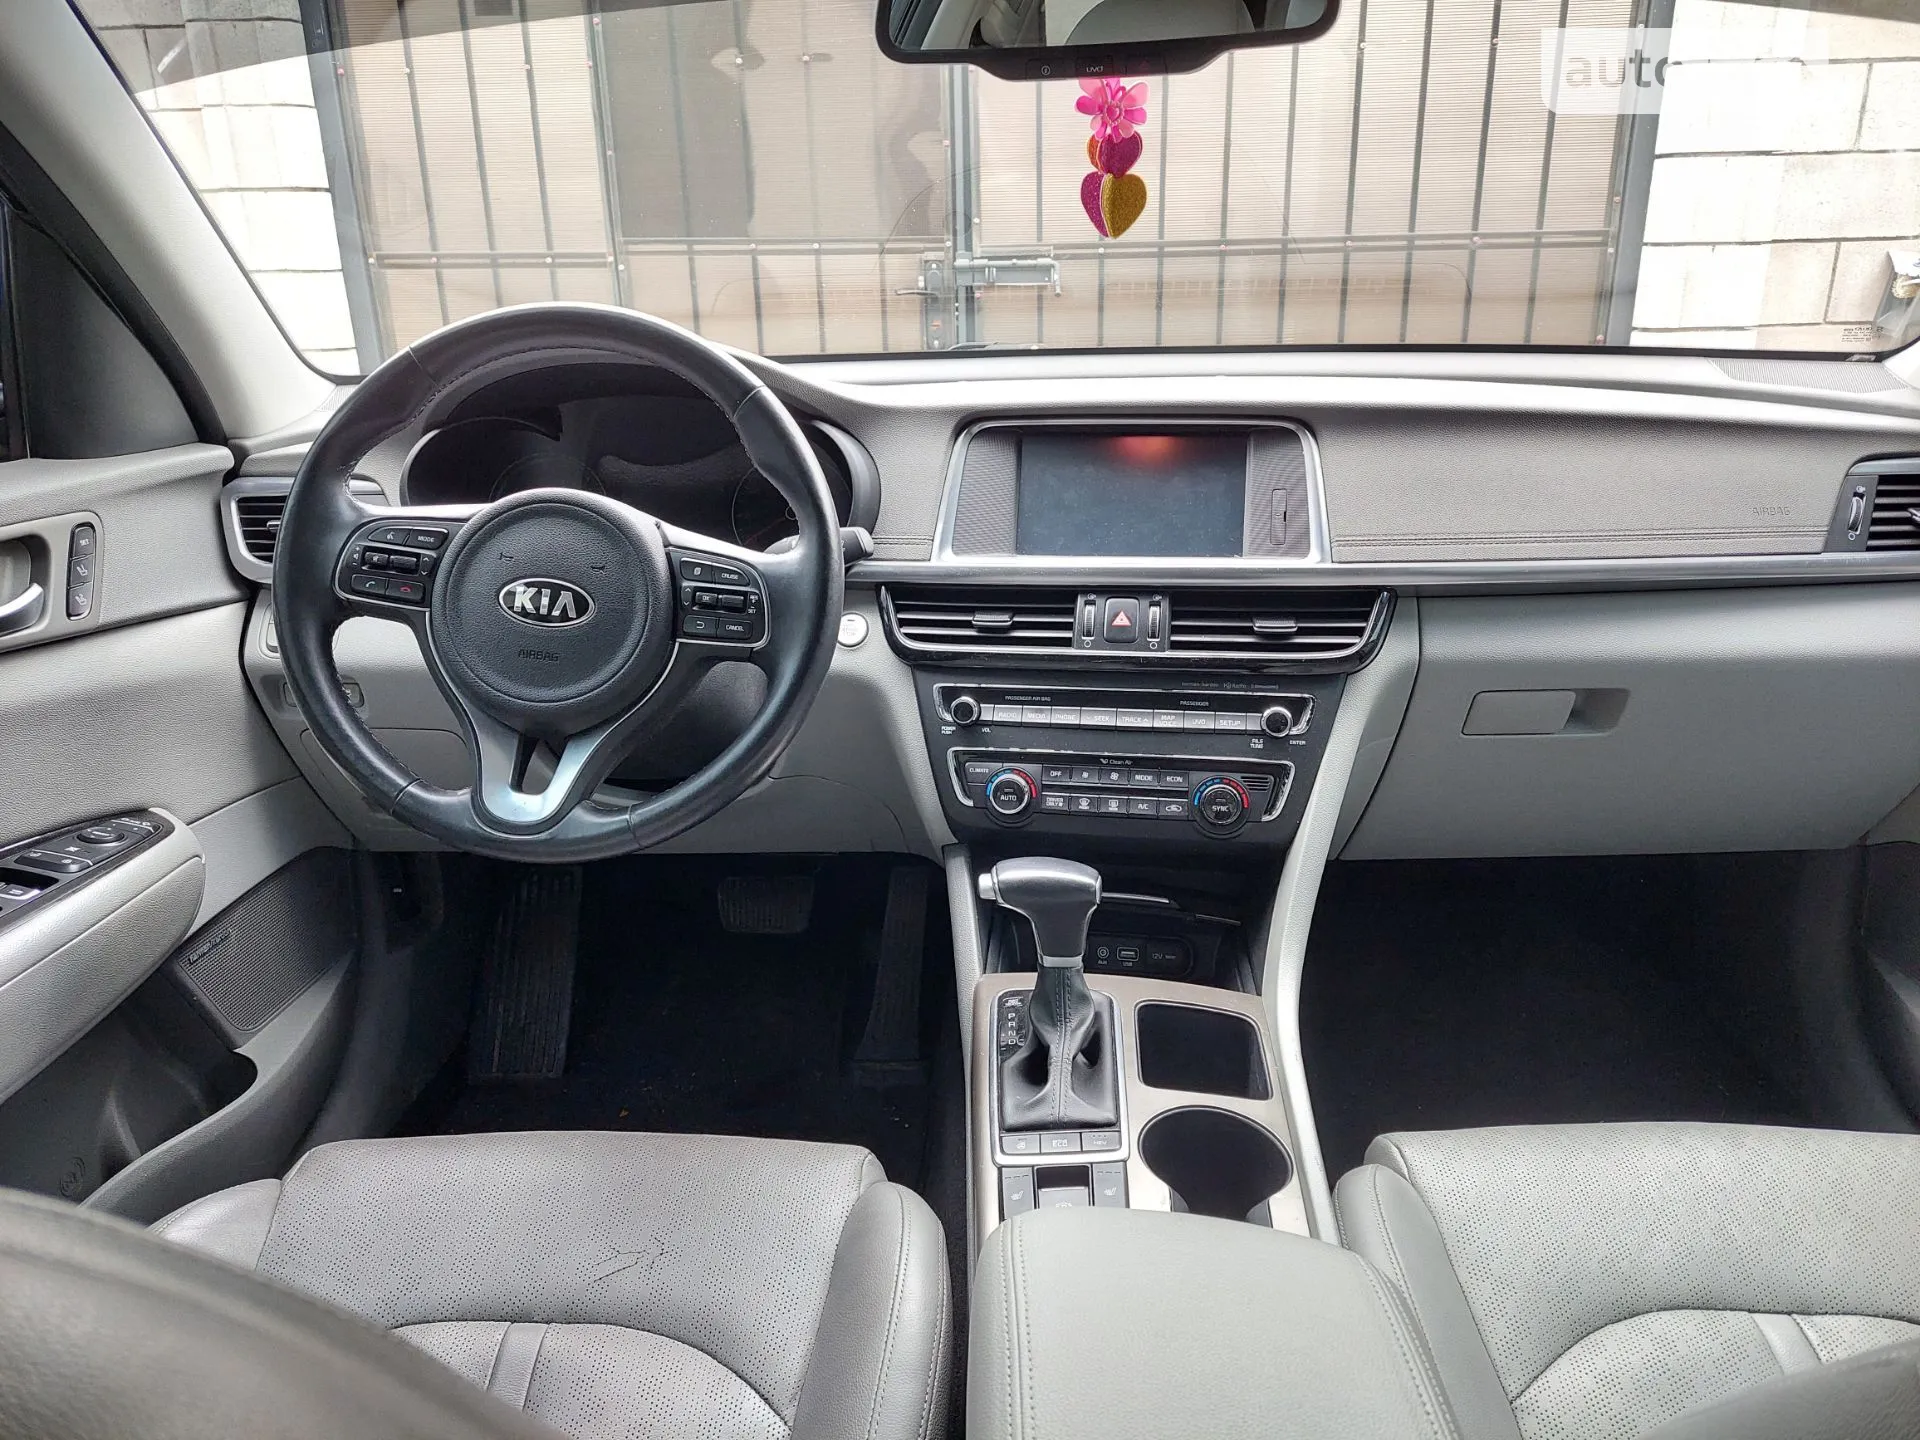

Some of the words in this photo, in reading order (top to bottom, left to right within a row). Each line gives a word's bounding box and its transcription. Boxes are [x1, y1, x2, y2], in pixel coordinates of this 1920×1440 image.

[1752, 506, 1791, 516] AIRBAG
[417, 535, 435, 543] MODE
[513, 586, 577, 618] KIA
[725, 624, 745, 632] CANCEL
[518, 649, 560, 662] AIRBAG
[1135, 774, 1153, 782] MODE
[1052, 1138, 1069, 1148] ECO
